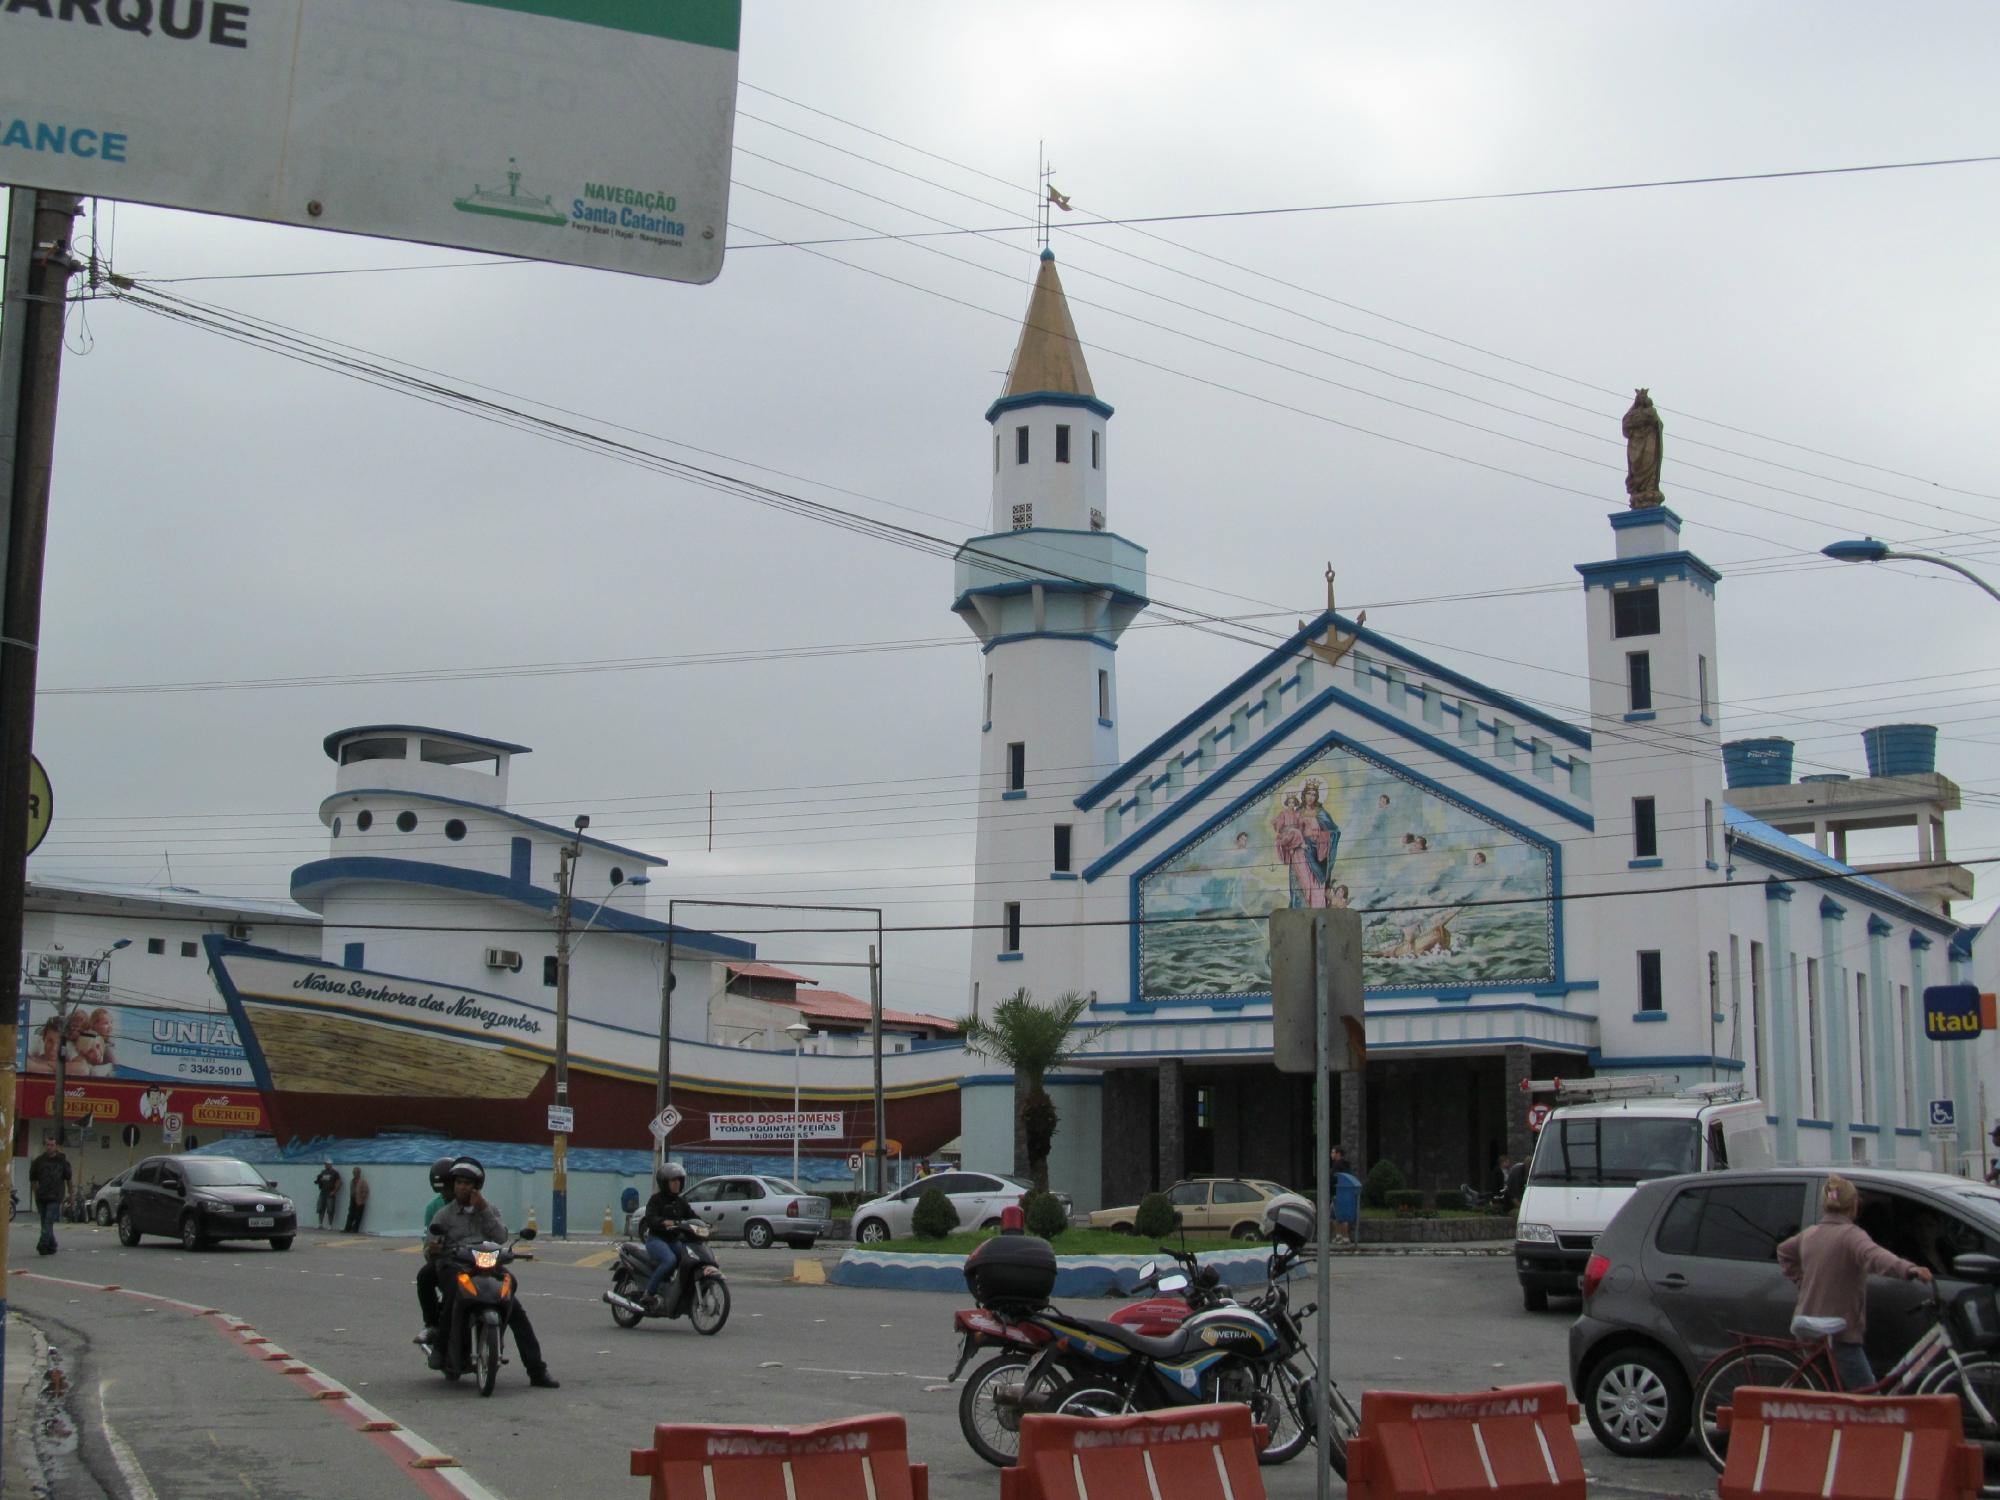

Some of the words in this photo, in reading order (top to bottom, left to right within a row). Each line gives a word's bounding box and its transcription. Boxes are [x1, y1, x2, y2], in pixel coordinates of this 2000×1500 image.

[584, 182, 677, 213] NAVEGAÇÃO
[572, 198, 618, 225] Santa
[620, 207, 686, 237] Catarina
[293, 972, 346, 994] Nossa
[347, 980, 417, 1007] Senhora
[418, 993, 444, 1012] dos
[446, 996, 541, 1034] Navegantes
[1928, 1010, 1978, 1032] Itaú
[190, 1063, 242, 1076] 3342-5010
[64, 1086, 86, 1098] onto
[52, 1101, 113, 1113] OERICH
[202, 1095, 230, 1108] ponto
[198, 1108, 255, 1121] KOERICH
[711, 1114, 754, 1125] TERÇO
